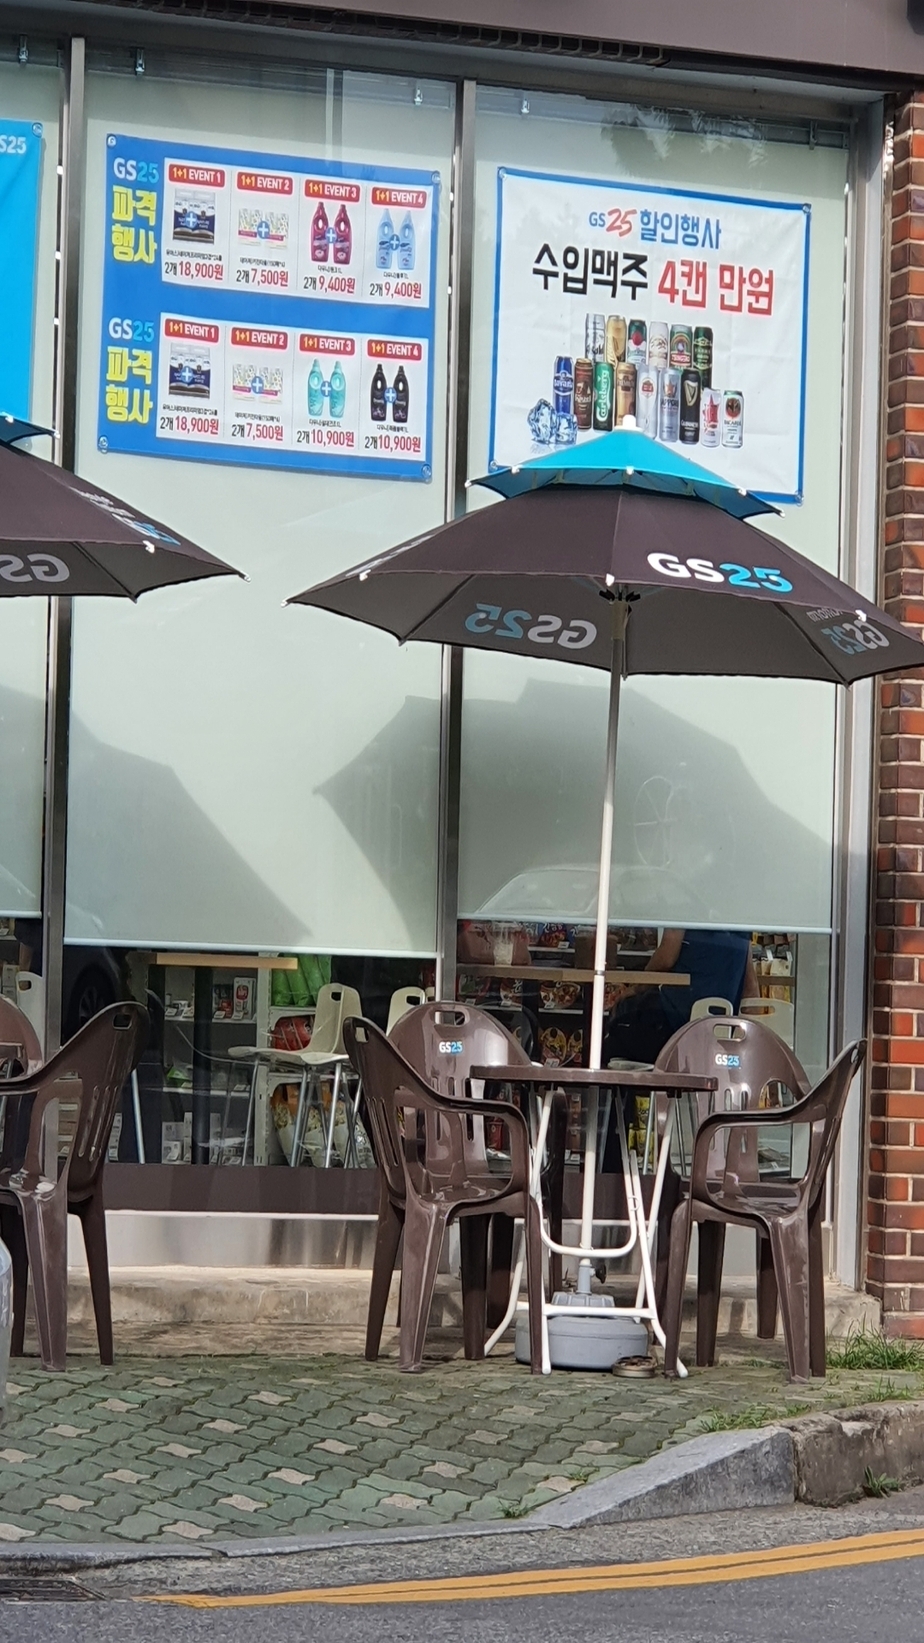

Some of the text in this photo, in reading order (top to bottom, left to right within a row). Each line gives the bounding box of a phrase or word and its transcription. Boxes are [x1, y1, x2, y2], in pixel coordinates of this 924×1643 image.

[113, 157, 159, 183] GS25
[172, 167, 221, 183] 1+1 EVENT 1
[240, 175, 290, 190] 1+1 EVENT 2
[308, 182, 357, 198] 1+1 EVENT 3
[112, 185, 157, 226] 파격
[375, 190, 424, 204] 1+1 EVENT 4
[588, 207, 722, 250] GS25 할인행사
[111, 223, 157, 264] 행사
[164, 262, 177, 276] 2개
[179, 262, 223, 281] 18,900원
[236, 268, 289, 289] 2개 7,500원
[532, 244, 775, 316] 수입맥주 4캔 만원
[303, 275, 356, 294] 2개 9,400원
[369, 282, 422, 300] 2개 9,400원
[108, 317, 155, 343] GS25
[169, 321, 216, 339] 1+1 EVENT 1
[235, 330, 284, 346] 1+1 EVENT 2
[303, 336, 352, 352] 1+1 EVENT 3
[371, 342, 419, 357] 1+1 EVENT 4
[106, 345, 153, 385] 파격
[105, 383, 153, 425] 행사
[160, 416, 174, 431] 2개
[175, 416, 219, 435] 18,900원
[232, 422, 284, 441] 2개 7,500원
[296, 429, 355, 448] 2개 10,900원
[364, 435, 422, 453] 2개 10,900원
[646, 551, 792, 594] GS25
[439, 1041, 463, 1054] GS25
[715, 1054, 740, 1066] GS25
